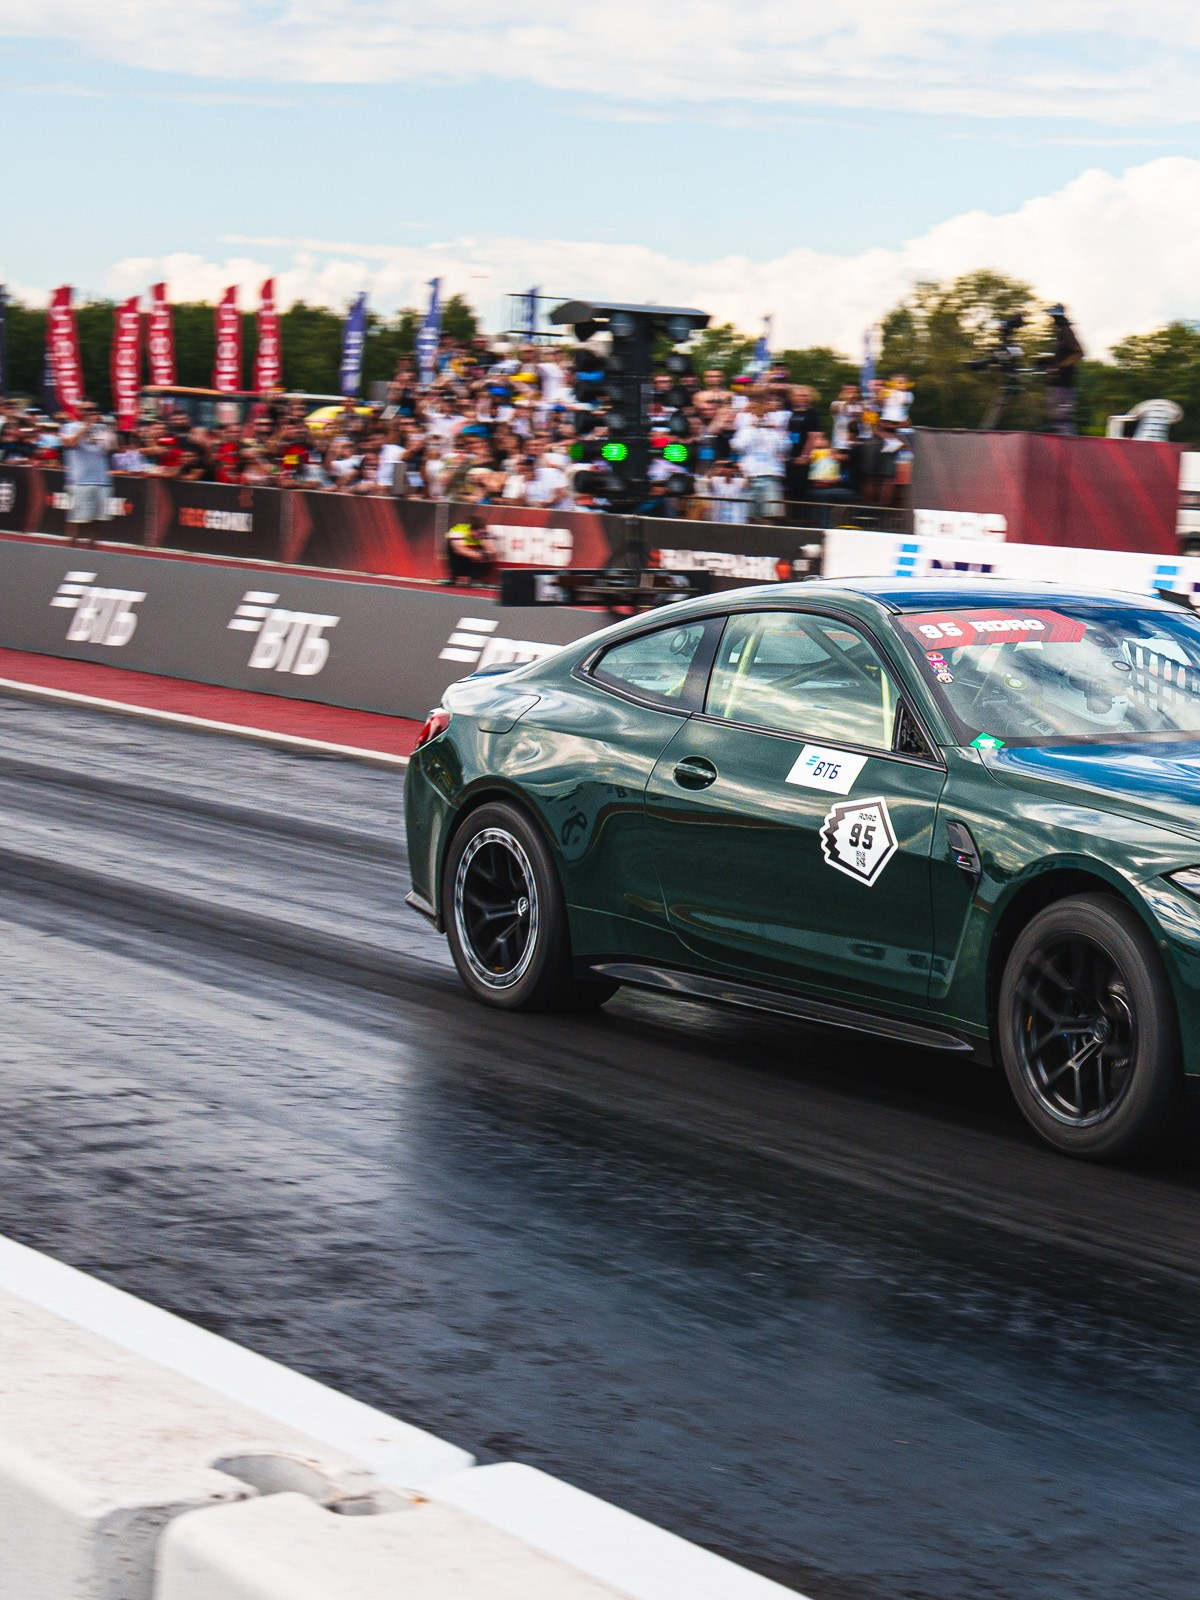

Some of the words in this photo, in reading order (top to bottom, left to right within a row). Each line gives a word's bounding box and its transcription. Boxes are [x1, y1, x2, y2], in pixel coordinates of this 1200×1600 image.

[66, 586, 148, 647] ВТБ
[247, 608, 341, 676] ВТБ
[918, 622, 964, 639] 95
[813, 761, 842, 780] ВТБ
[848, 823, 877, 850] 95
